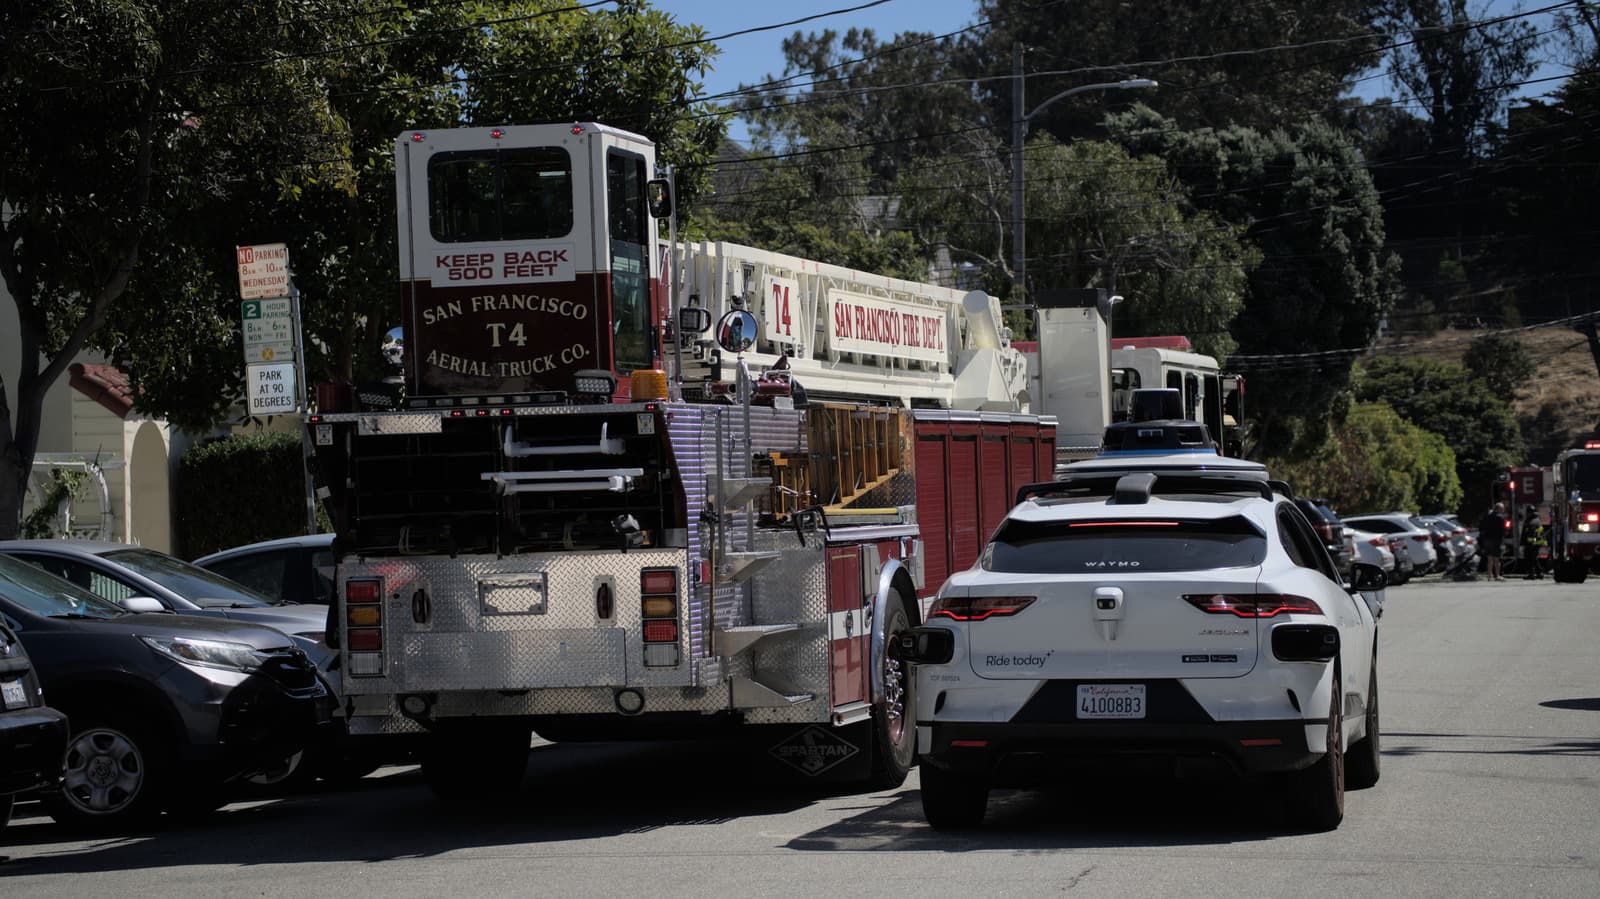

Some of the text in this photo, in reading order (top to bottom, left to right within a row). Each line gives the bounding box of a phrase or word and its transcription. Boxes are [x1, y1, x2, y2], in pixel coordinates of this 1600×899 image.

[239, 248, 285, 263] NO PARKING
[436, 249, 568, 268] KEEP BACK
[449, 264, 558, 281] 500 FEET
[243, 276, 285, 288] WEDNESDAY
[246, 303, 257, 317] 2
[266, 302, 285, 310] HOUR
[423, 294, 588, 325] SAN FRANCISCO
[772, 284, 791, 336] T4
[263, 311, 290, 319] PARKING
[834, 301, 943, 350] SAN FRANCISCO FIRE DEPT.
[486, 322, 528, 347] T4
[426, 343, 590, 377] AERIAL TRUCK CO.
[260, 371, 282, 380] PARK
[260, 384, 284, 394] AT 90
[254, 397, 291, 407] DEGREES
[1523, 477, 1534, 494] E
[985, 654, 1047, 668] Ride today
[1081, 697, 1141, 713] 41008B3
[779, 745, 848, 756] SPARTAN
